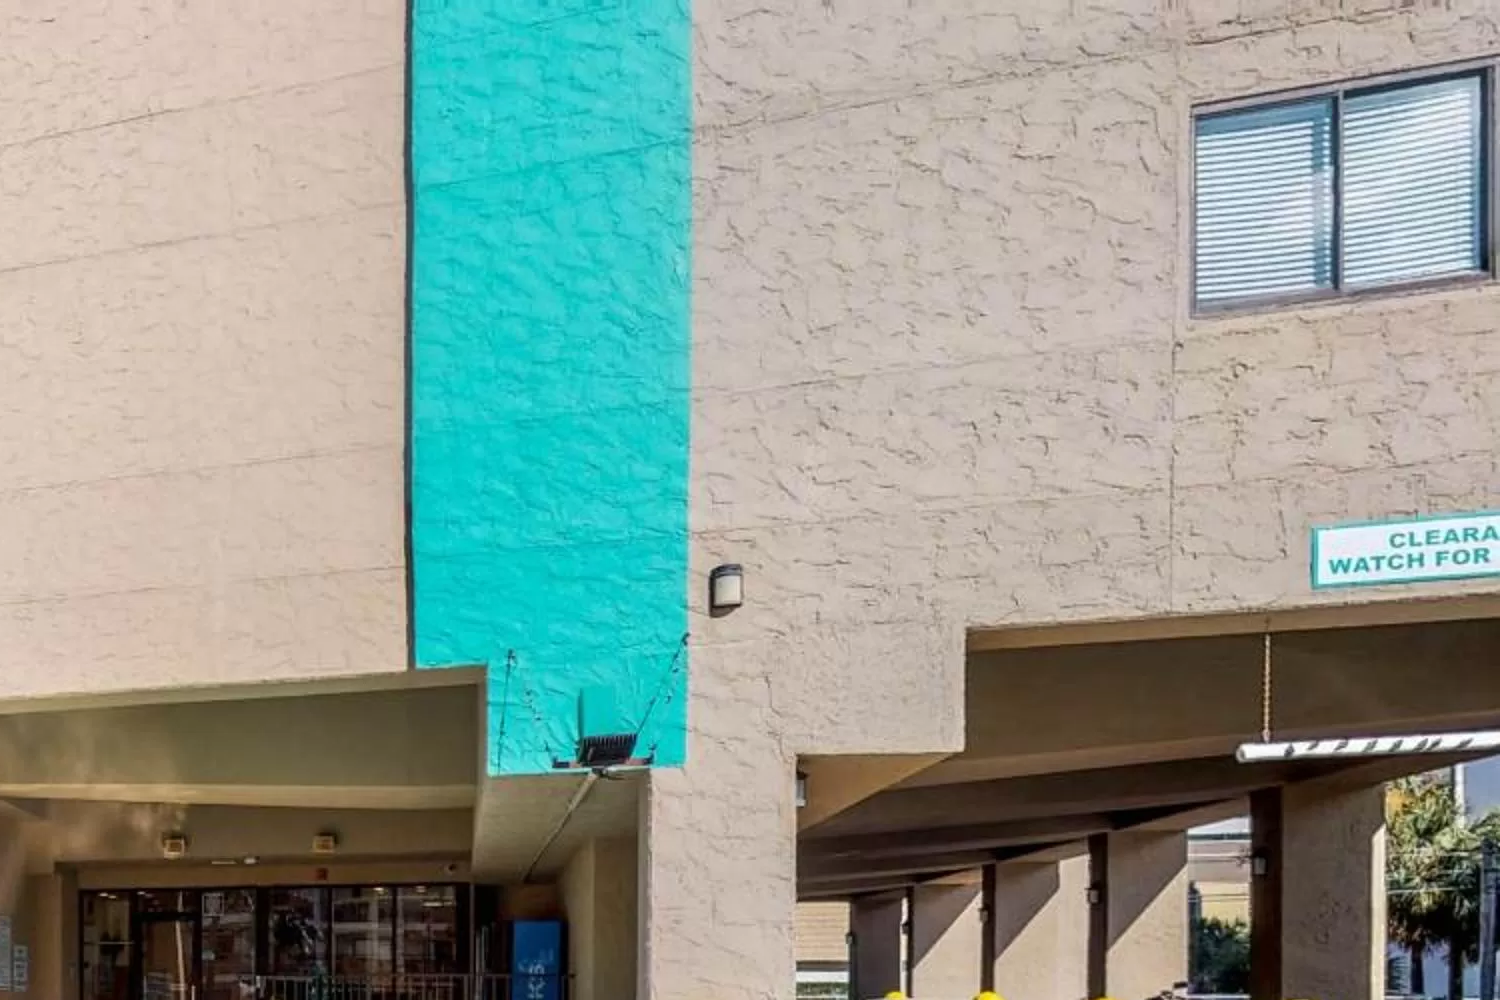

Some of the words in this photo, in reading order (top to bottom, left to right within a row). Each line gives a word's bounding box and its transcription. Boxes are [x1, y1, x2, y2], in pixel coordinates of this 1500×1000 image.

[1388, 525, 1500, 549] CLEARA
[1329, 552, 1425, 575] WATCH
[1435, 547, 1491, 567] FOR
